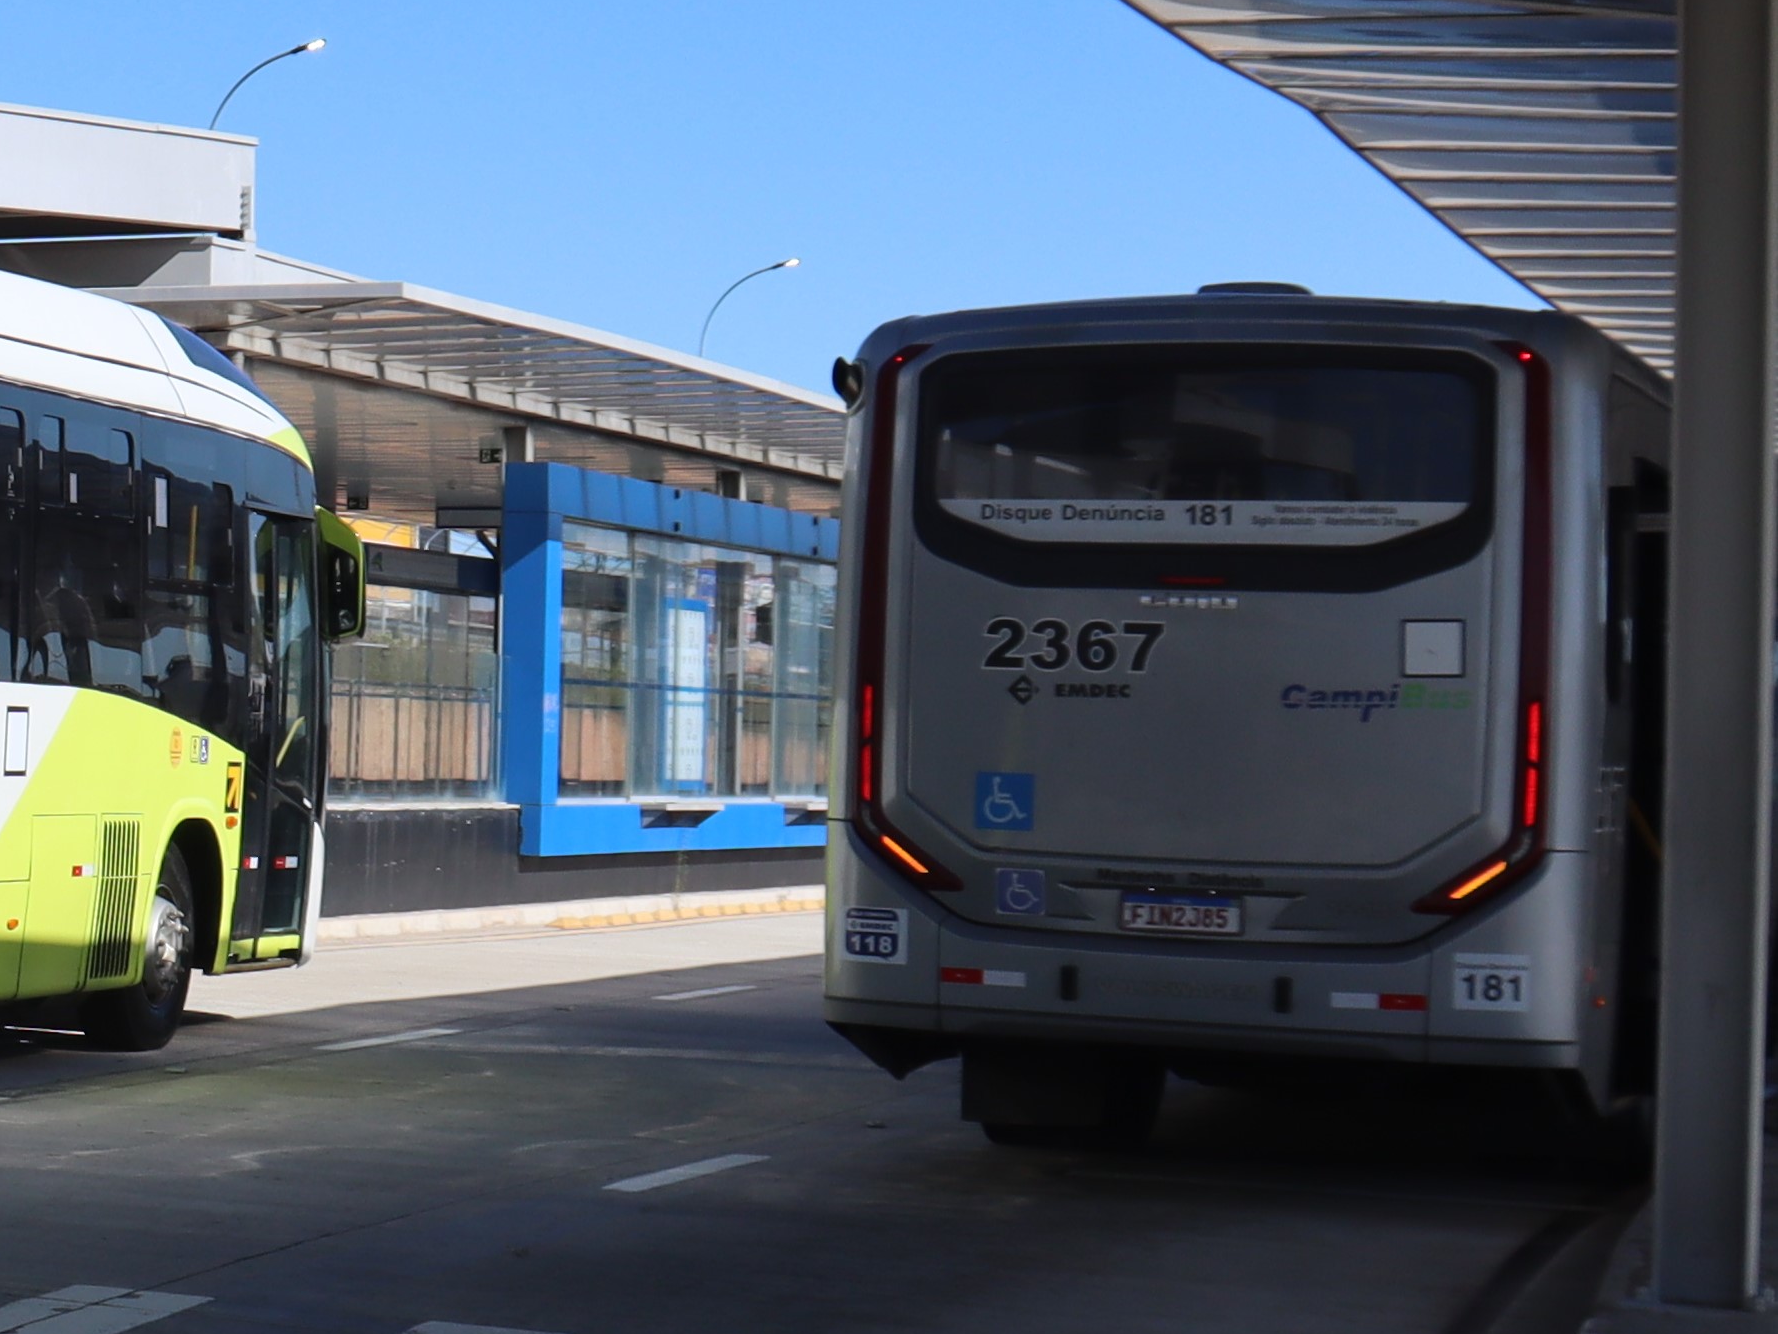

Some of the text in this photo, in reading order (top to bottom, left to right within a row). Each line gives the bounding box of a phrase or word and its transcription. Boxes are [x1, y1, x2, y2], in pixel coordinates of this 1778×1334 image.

[981, 503, 1234, 526] Disque Denúncia 181
[984, 618, 1165, 672] 2367
[1055, 684, 1131, 699] EMDEC
[860, 921, 894, 931] EMDEC
[1131, 905, 1229, 929] FIN2J85
[850, 934, 893, 953] 118
[1461, 974, 1522, 1002] 181
